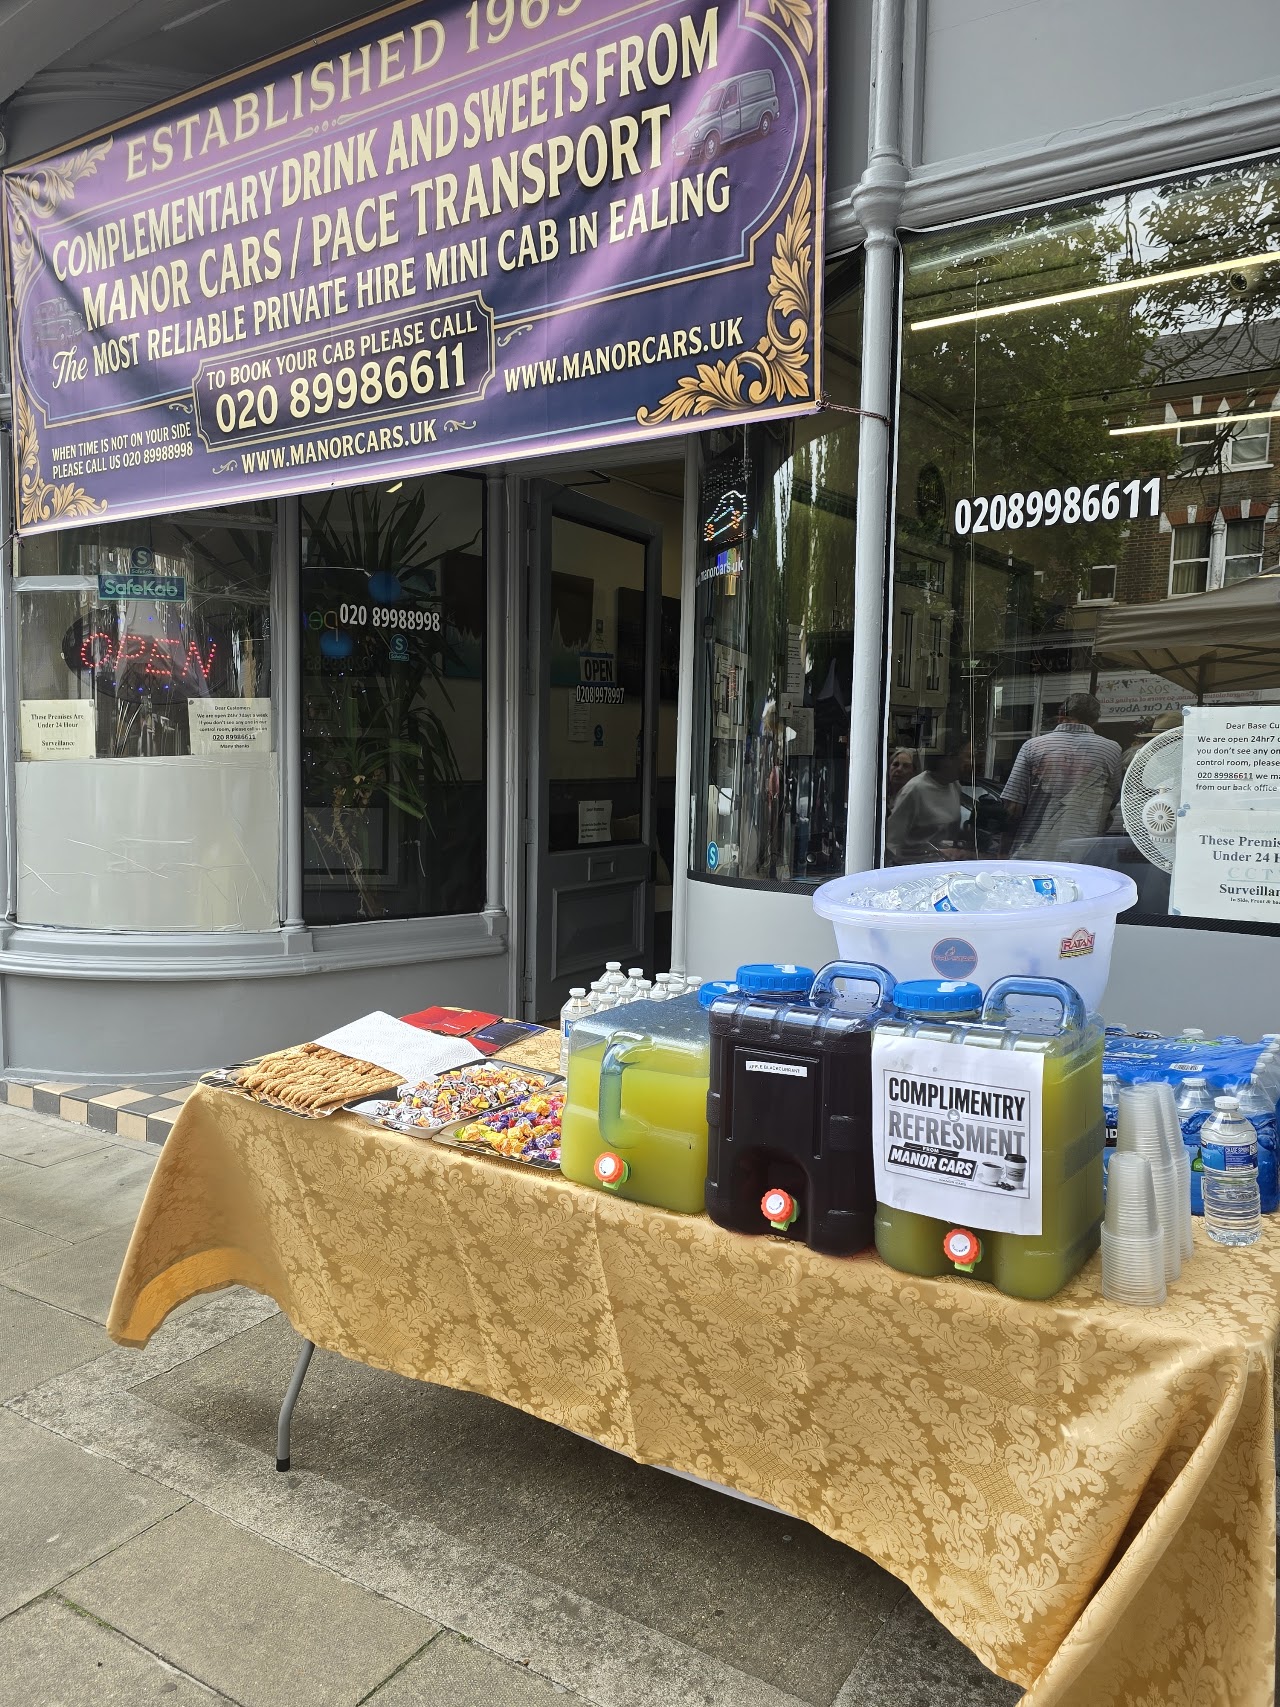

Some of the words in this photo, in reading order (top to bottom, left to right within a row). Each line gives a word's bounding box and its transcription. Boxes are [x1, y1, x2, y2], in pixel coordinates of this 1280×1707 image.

[125, 19, 445, 182] ESTABLISHED
[465, 0, 582, 53] 196
[52, 165, 276, 282] COMPLEMENTARY
[281, 127, 378, 208] DRINK
[386, 102, 458, 177] AND
[463, 52, 589, 150] SWEETS
[595, 7, 719, 106] FROM
[82, 259, 191, 332] MANOR
[200, 227, 283, 299] CARS
[290, 217, 303, 280] /
[312, 191, 401, 268] PACE
[411, 103, 671, 237] TRANSPORT
[52, 344, 88, 390] The
[93, 332, 140, 378] MOST
[147, 304, 247, 362] RELIABLE
[253, 279, 348, 337] PRIVATE
[357, 257, 416, 310] HIRE
[426, 237, 488, 292] MINI
[497, 218, 559, 272] CAB
[569, 211, 599, 256] IN
[609, 166, 731, 245] EALING
[206, 369, 225, 391] TO
[230, 363, 272, 387] BOOK
[276, 353, 318, 381] YOUR
[321, 344, 355, 372] CAB
[360, 327, 425, 365] PLEASE
[430, 310, 478, 343] CALL
[504, 316, 743, 393] WWW.MANORCARS.UK
[215, 383, 278, 434] 020
[290, 342, 466, 420] 89986611
[52, 444, 77, 462] WHEN
[78, 441, 98, 457] TIME
[101, 438, 109, 453] IS
[111, 434, 128, 451] NOT
[131, 432, 143, 448] ON
[145, 426, 169, 444] YOUR
[171, 421, 192, 440] SIDE
[52, 461, 84, 479] PLEASE
[85, 457, 108, 474] CALL
[109, 454, 121, 470] US
[123, 451, 141, 468] 020
[143, 441, 193, 464] 89988998
[242, 418, 437, 475] WWW.MANORCARS.UK
[954, 477, 1161, 535] 02089986611
[104, 578, 178, 597] SafeKab
[340, 603, 367, 626] 020
[372, 607, 441, 632] 89988998
[80, 632, 217, 678] OPEN
[584, 659, 613, 682] OPEN
[1226, 722, 1246, 730] Dear
[1247, 722, 1267, 730] Base
[1227, 737, 1249, 745] open
[1196, 748, 1212, 756] you
[1253, 748, 1268, 756] any
[1226, 760, 1251, 768] room,
[1253, 759, 1280, 768] please
[1196, 783, 1215, 791] from
[1232, 784, 1252, 792] back
[1254, 784, 1278, 792] office
[1197, 772, 1212, 780] 020
[1214, 772, 1254, 780] 89986611
[1199, 834, 1235, 846] These
[1213, 850, 1252, 862] Under
[1255, 852, 1270, 863] 24
[1063, 936, 1094, 950] RATAN
[888, 1077, 1026, 1122] COMPLIMENTRY
[888, 1109, 1026, 1157] REFRESMENT
[890, 1147, 936, 1170] MANOR
[938, 1158, 974, 1177] CARS
